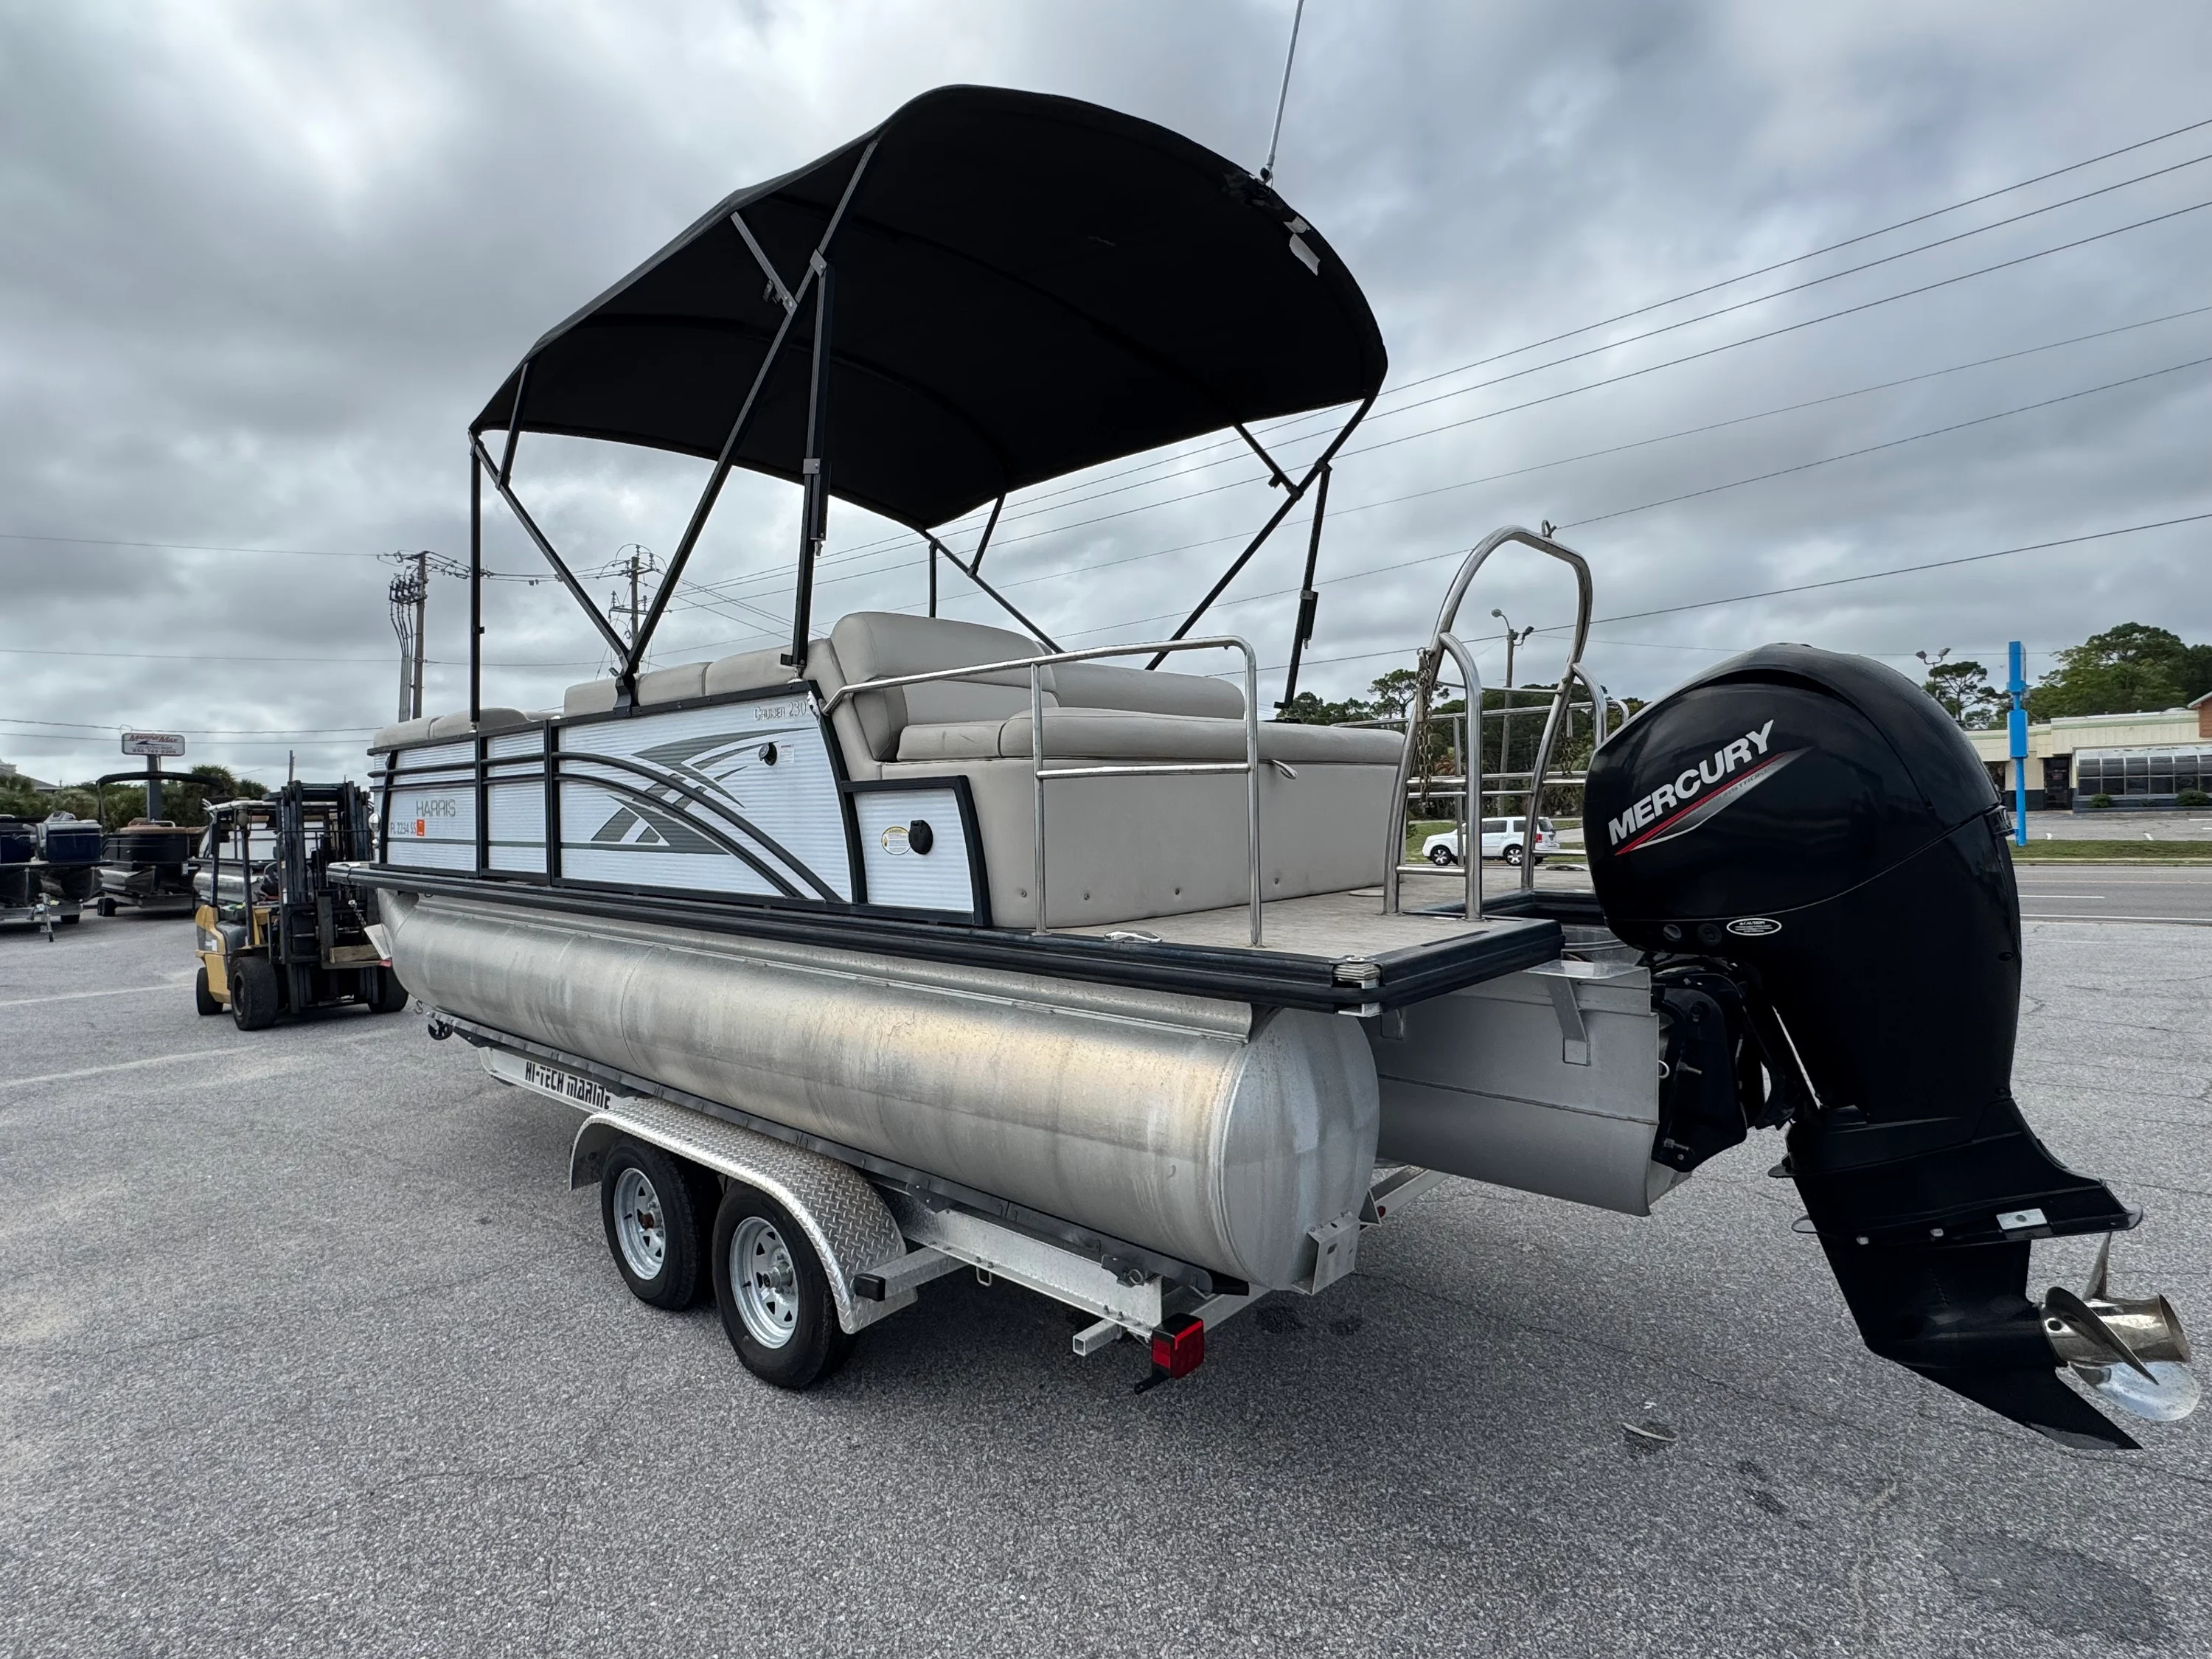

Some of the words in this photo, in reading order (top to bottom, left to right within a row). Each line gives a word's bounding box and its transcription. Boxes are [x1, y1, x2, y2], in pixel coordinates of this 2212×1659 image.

[754, 706, 786, 720] CRUISER
[788, 700, 807, 717] 230
[1608, 719, 1775, 846] MERCURY
[416, 799, 456, 818] HARRIS
[397, 821, 409, 835] 2234
[525, 1061, 565, 1093] HI-TECH
